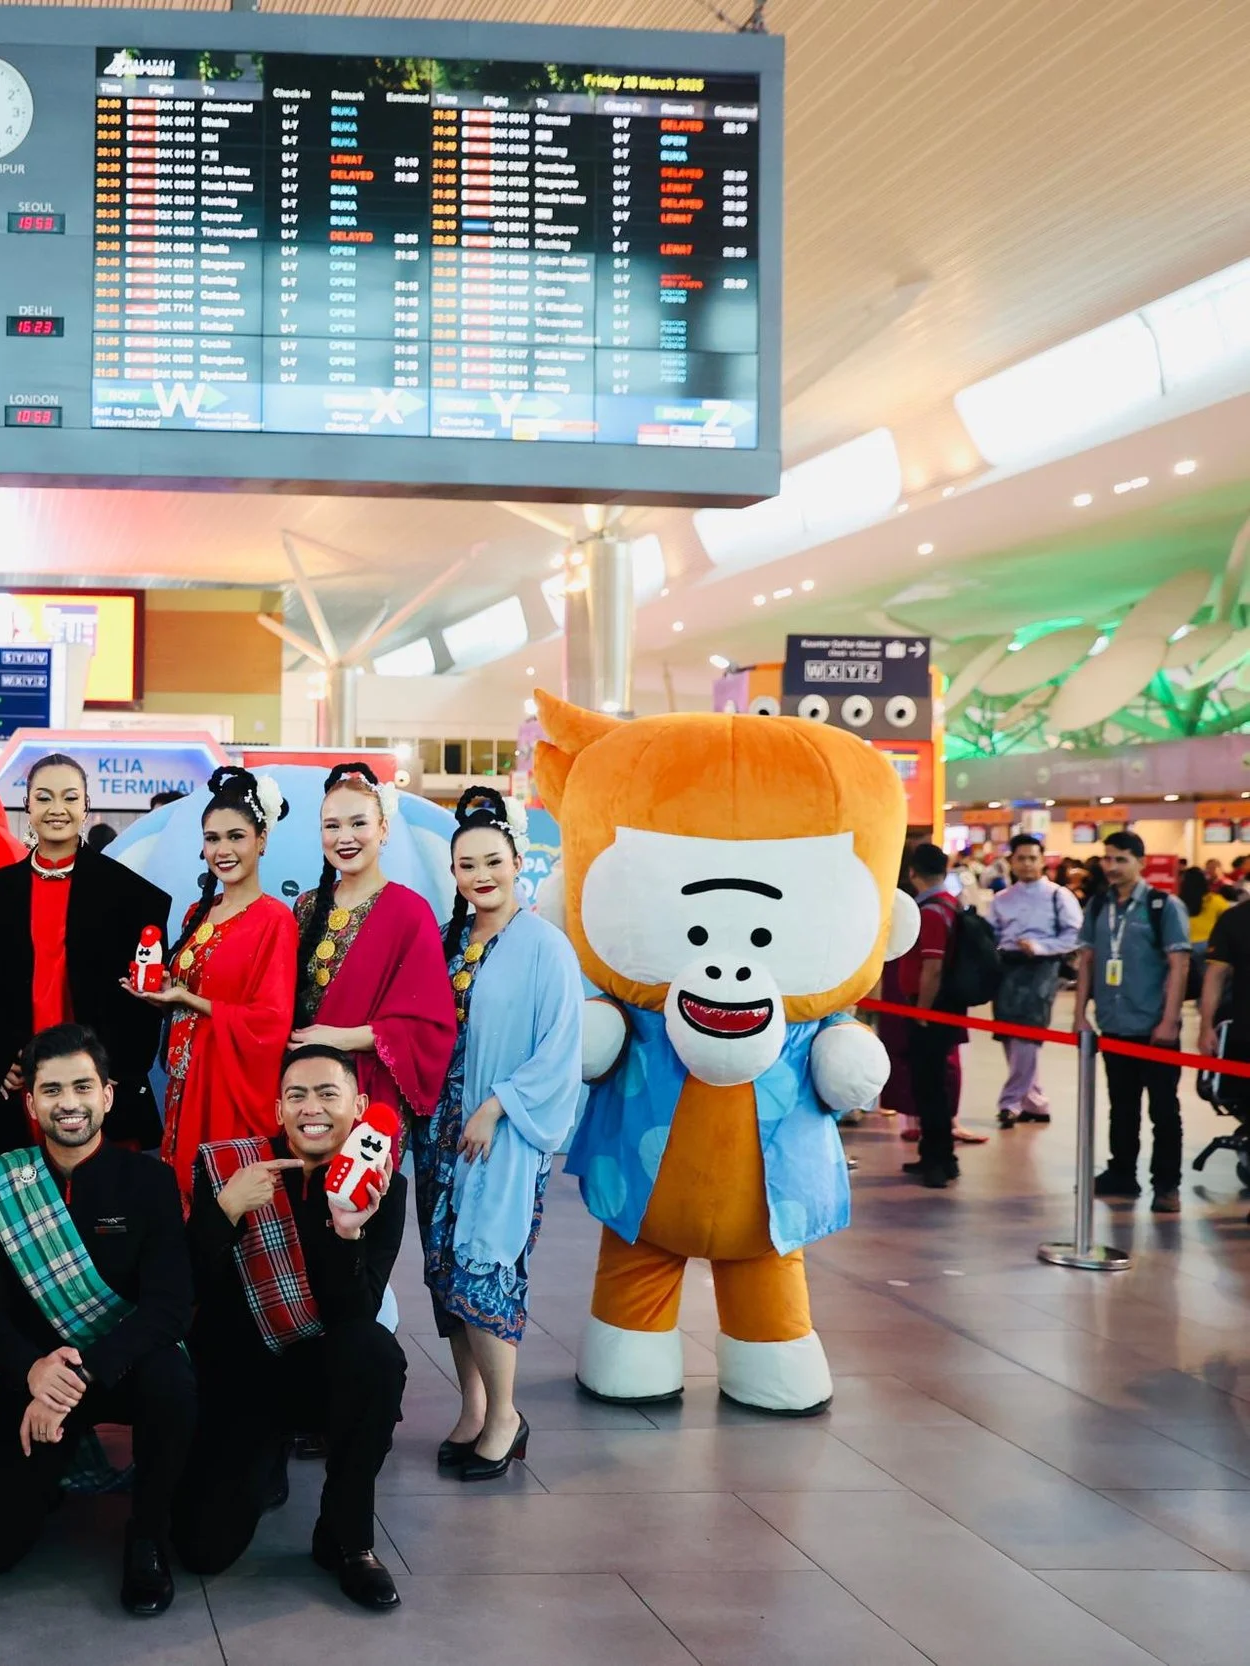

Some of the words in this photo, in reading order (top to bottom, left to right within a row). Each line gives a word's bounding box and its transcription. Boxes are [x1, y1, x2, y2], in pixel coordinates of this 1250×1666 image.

[584, 74, 622, 90] Friday
[639, 76, 675, 90] March
[8, 90, 16, 100] 2
[202, 85, 215, 96] To
[331, 90, 365, 101] Remark
[12, 107, 20, 118] 3
[6, 125, 13, 136] 4
[330, 170, 374, 181] DELAYED
[18, 202, 54, 212] SEOUL
[329, 246, 356, 256] OPEN
[18, 306, 52, 316] DELHI
[9, 394, 59, 404] LONDON
[152, 381, 207, 418] W
[368, 387, 404, 425] X
[489, 391, 524, 428] Y
[93, 406, 112, 416] Self
[114, 408, 135, 418] Bag
[136, 408, 161, 418] Drop
[700, 400, 732, 435] Z
[95, 418, 161, 428] International
[806, 664, 823, 678] W
[827, 666, 840, 678] X
[846, 666, 858, 678] Y
[866, 666, 877, 680] Z
[98, 758, 144, 773] KLIA
